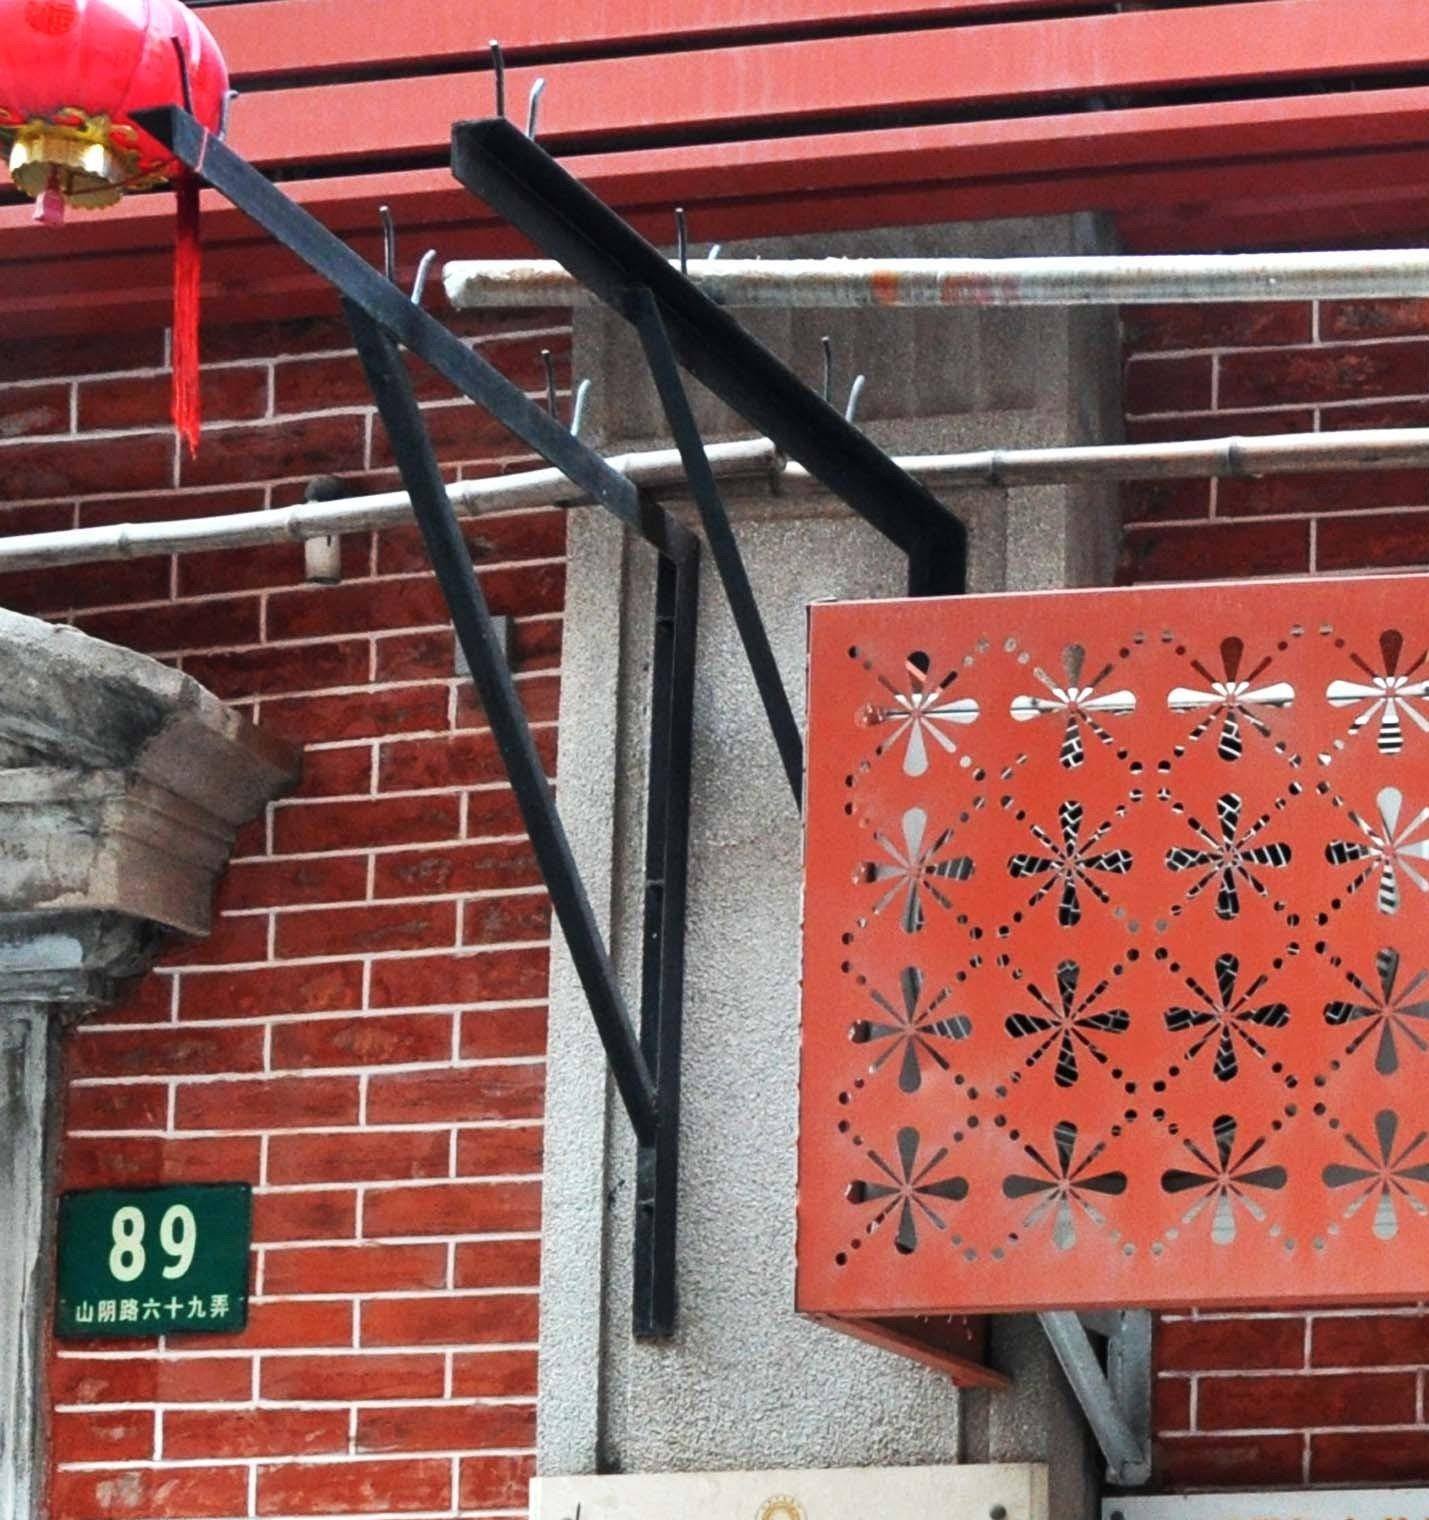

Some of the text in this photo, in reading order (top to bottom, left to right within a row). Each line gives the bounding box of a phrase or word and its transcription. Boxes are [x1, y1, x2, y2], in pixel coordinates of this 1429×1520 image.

[109, 1204, 196, 1282] 89
[75, 1294, 230, 1323] 山阴路六十九弄
